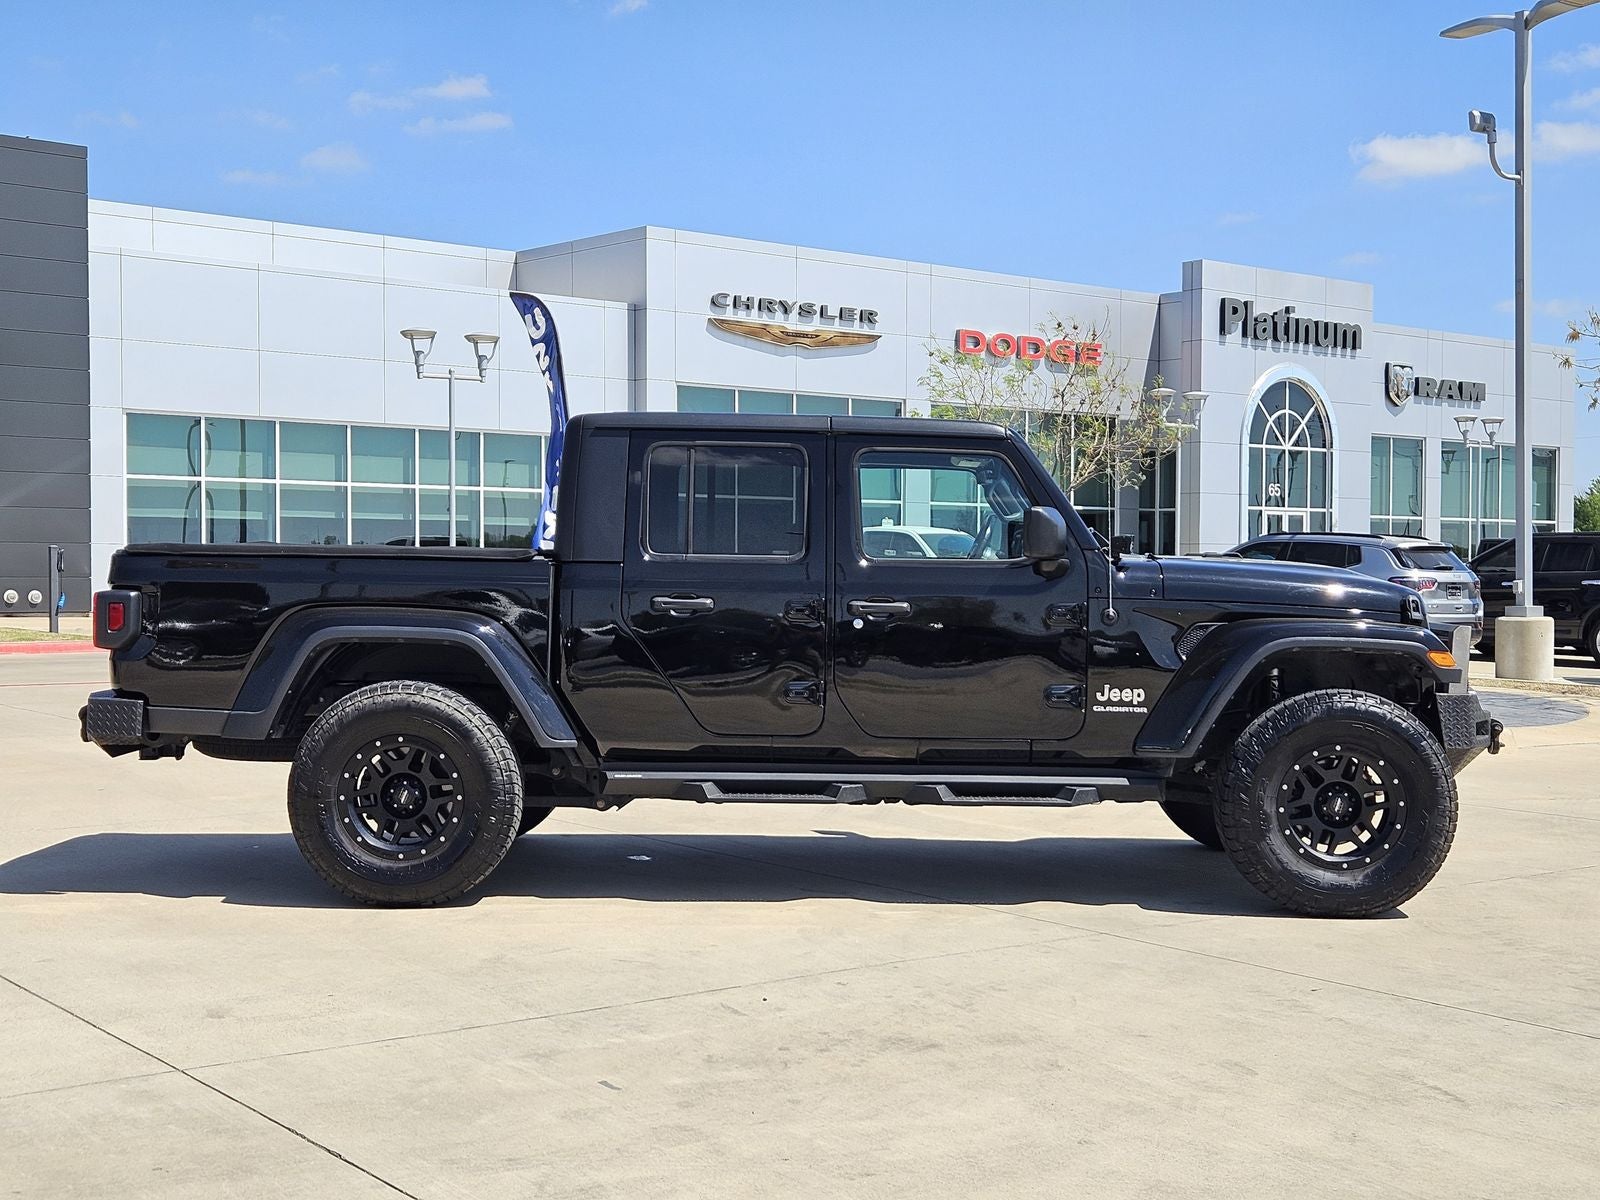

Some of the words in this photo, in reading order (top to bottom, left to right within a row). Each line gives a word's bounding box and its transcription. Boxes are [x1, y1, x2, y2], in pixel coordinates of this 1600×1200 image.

[711, 292, 879, 325] CHRYSLER
[1219, 297, 1362, 350] Platinum
[954, 328, 1103, 366] DODGE
[1414, 376, 1487, 402] RAM
[1268, 483, 1281, 497] 65
[1095, 684, 1146, 705] Jeep
[1092, 705, 1149, 714] GLADIATOR
